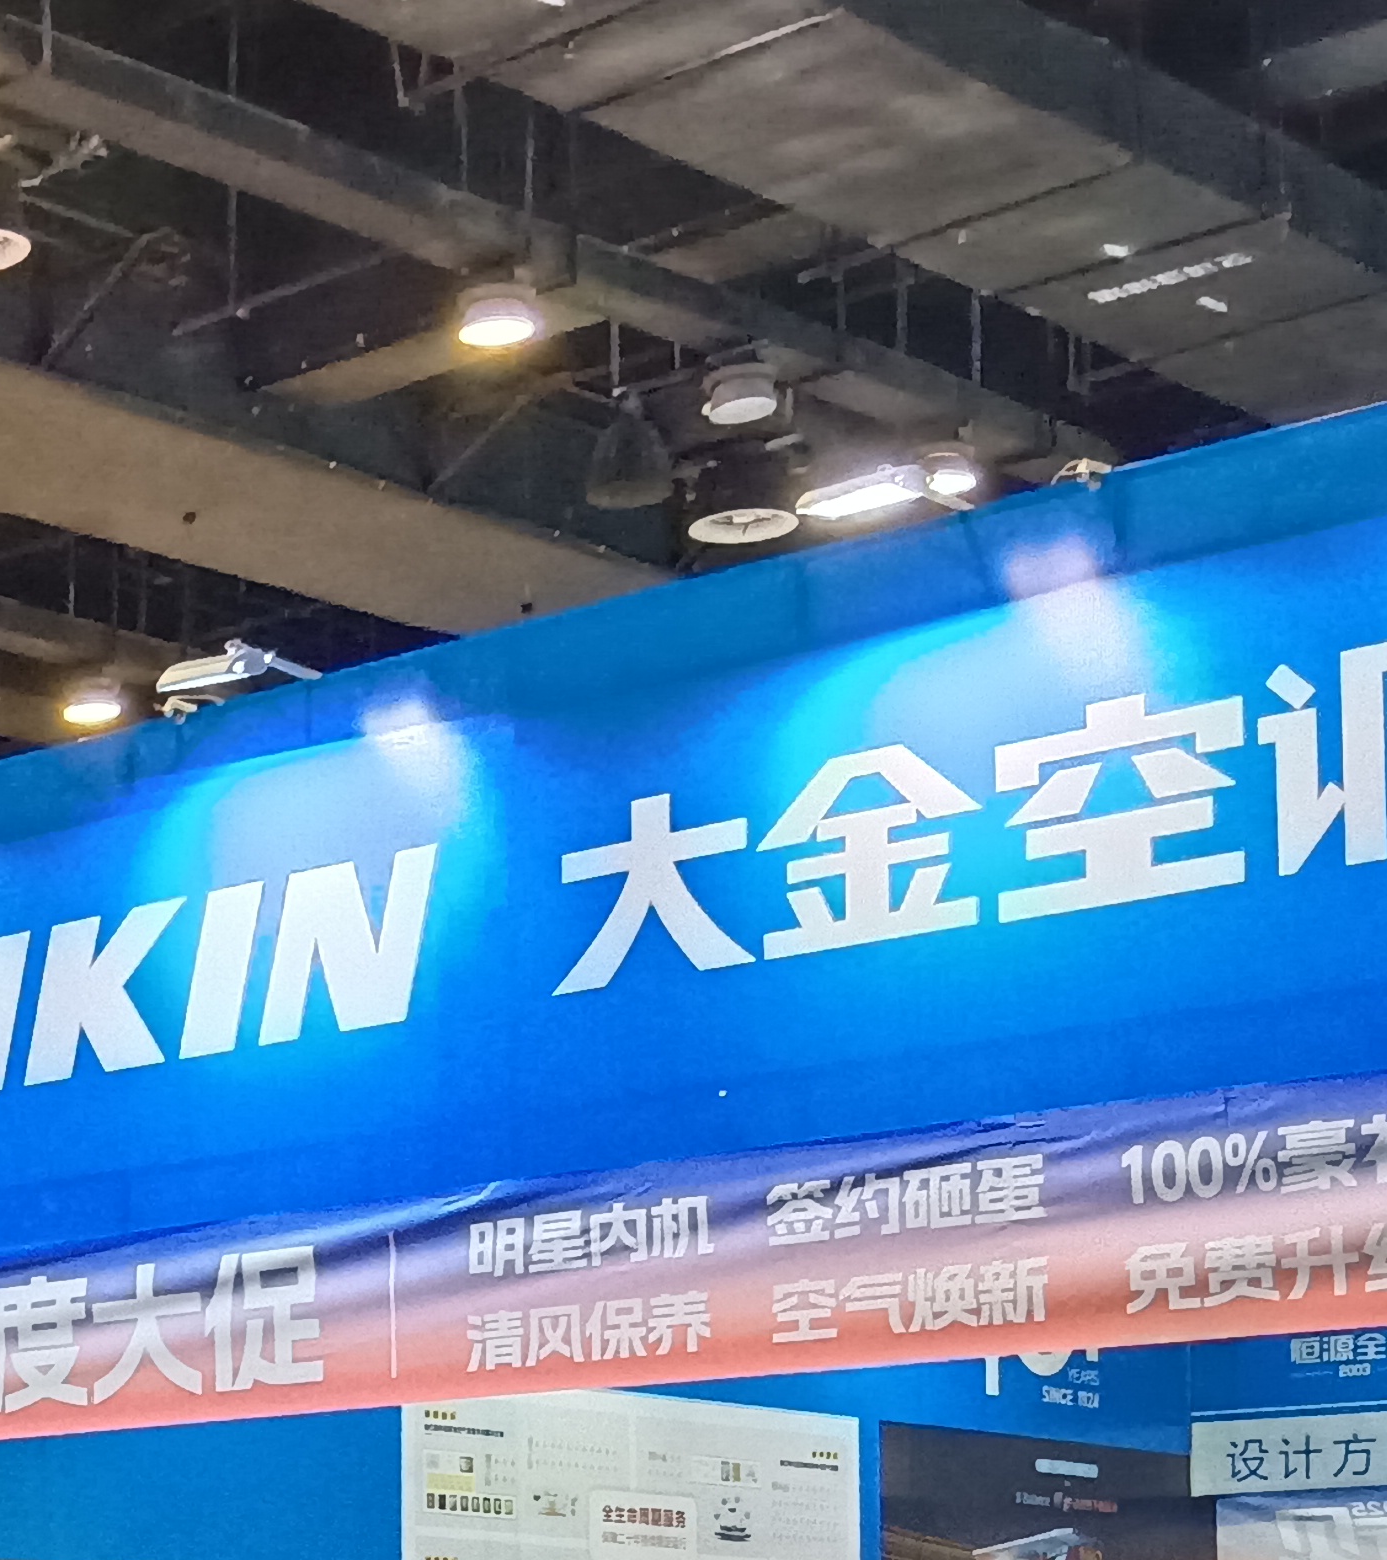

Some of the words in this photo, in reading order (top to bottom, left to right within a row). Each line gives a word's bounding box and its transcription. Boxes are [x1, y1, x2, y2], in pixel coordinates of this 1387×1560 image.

[467, 1195, 714, 1279] 明星内机
[766, 1153, 1046, 1247] 签约砸蛋
[466, 1290, 712, 1374] 清风保养
[772, 1256, 1048, 1344] 空气焕新
[1227, 1433, 1377, 1482] 设计方
